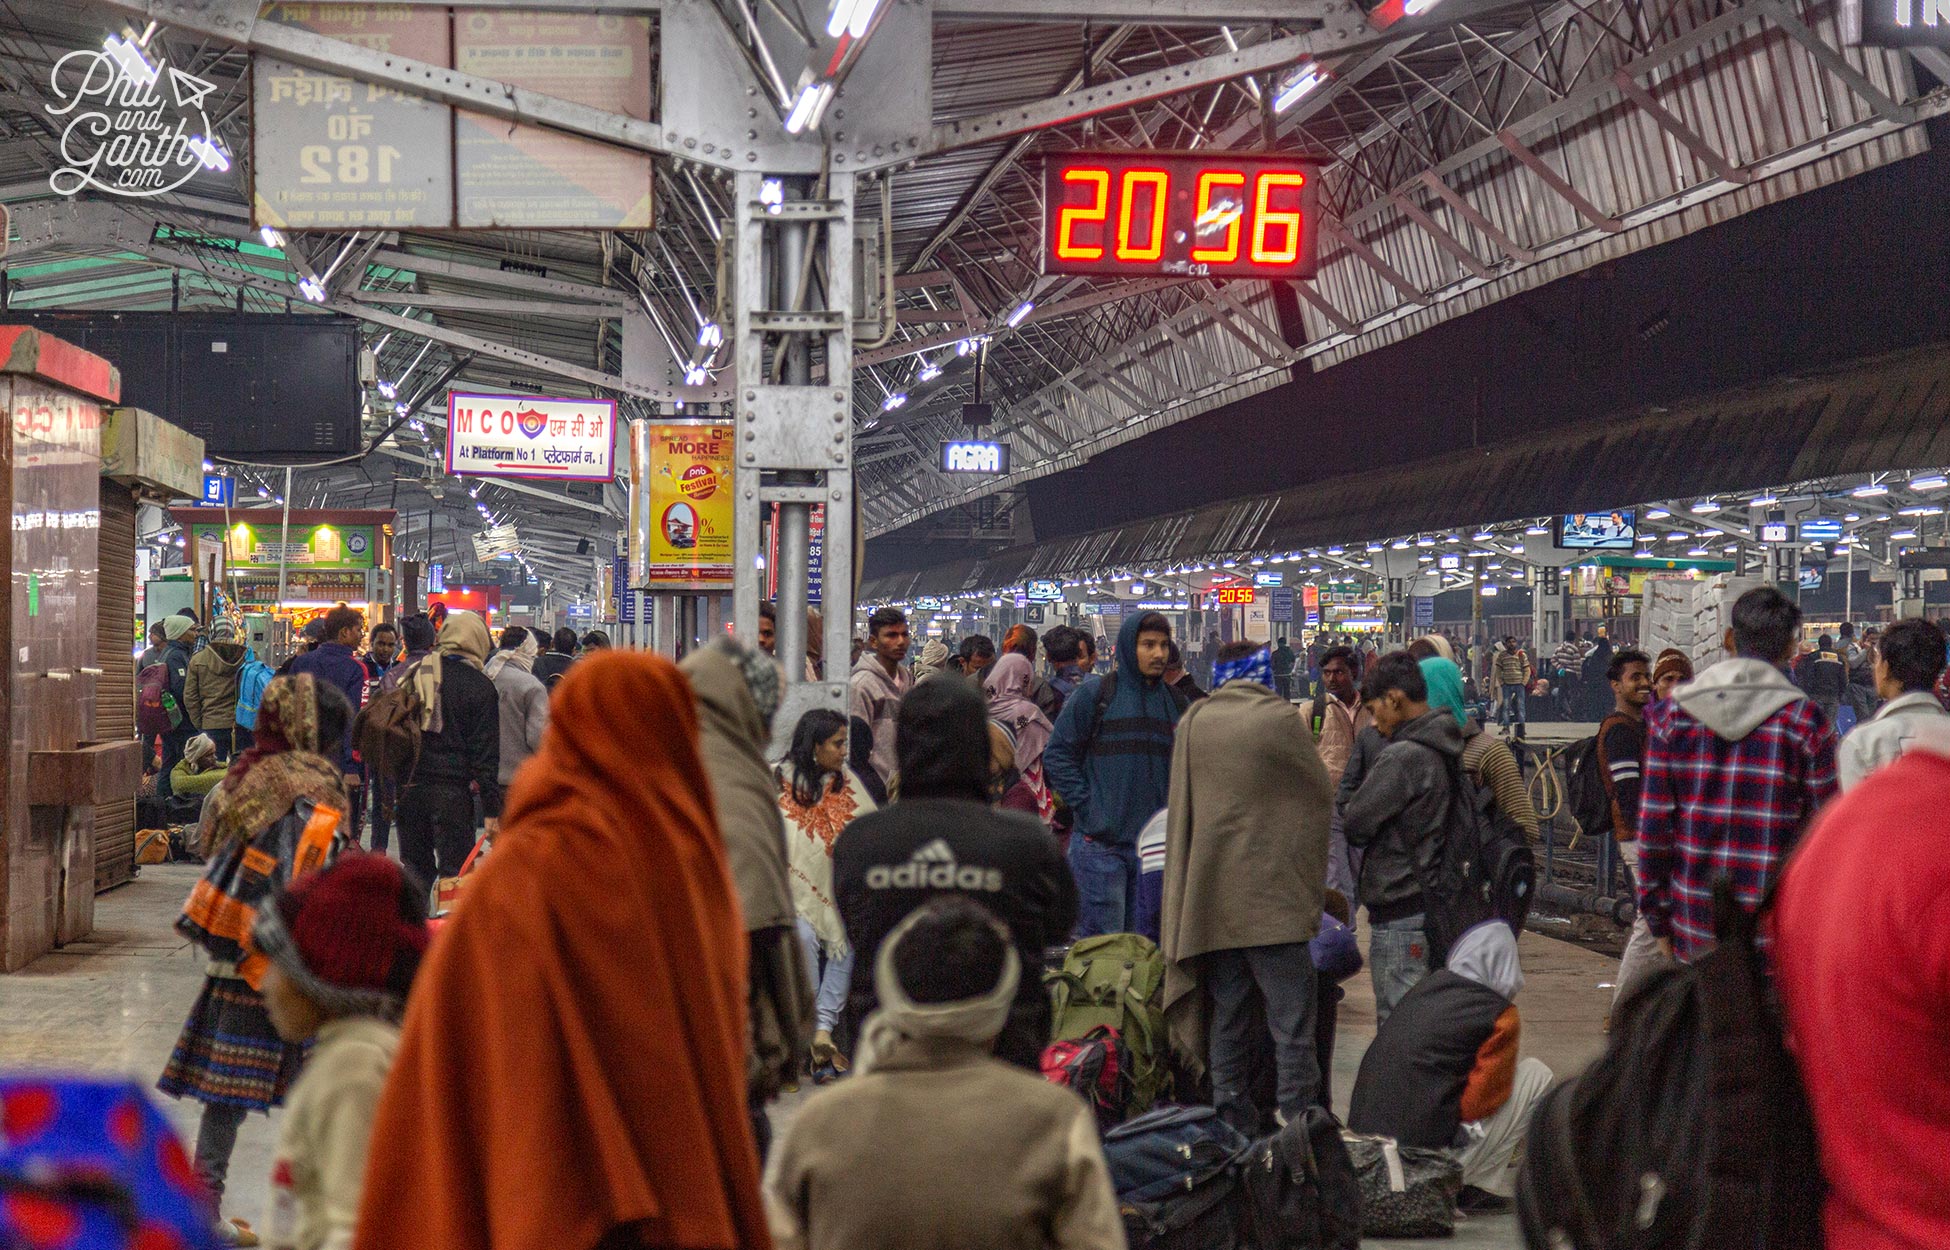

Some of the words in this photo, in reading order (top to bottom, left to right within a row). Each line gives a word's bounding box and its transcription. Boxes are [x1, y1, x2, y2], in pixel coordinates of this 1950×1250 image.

[459, 445, 469, 458] At
[472, 446, 514, 461] Platform
[516, 448, 528, 461] No
[531, 448, 535, 461] 1
[543, 445, 582, 464] प्लेटफार्म
[599, 453, 603, 465] 1
[668, 443, 719, 454] MORE
[948, 445, 999, 470] AGRA
[689, 467, 707, 477] pnb
[680, 476, 717, 493] Festival
[1028, 607, 1039, 619] 4
[866, 863, 1002, 892] adidas
